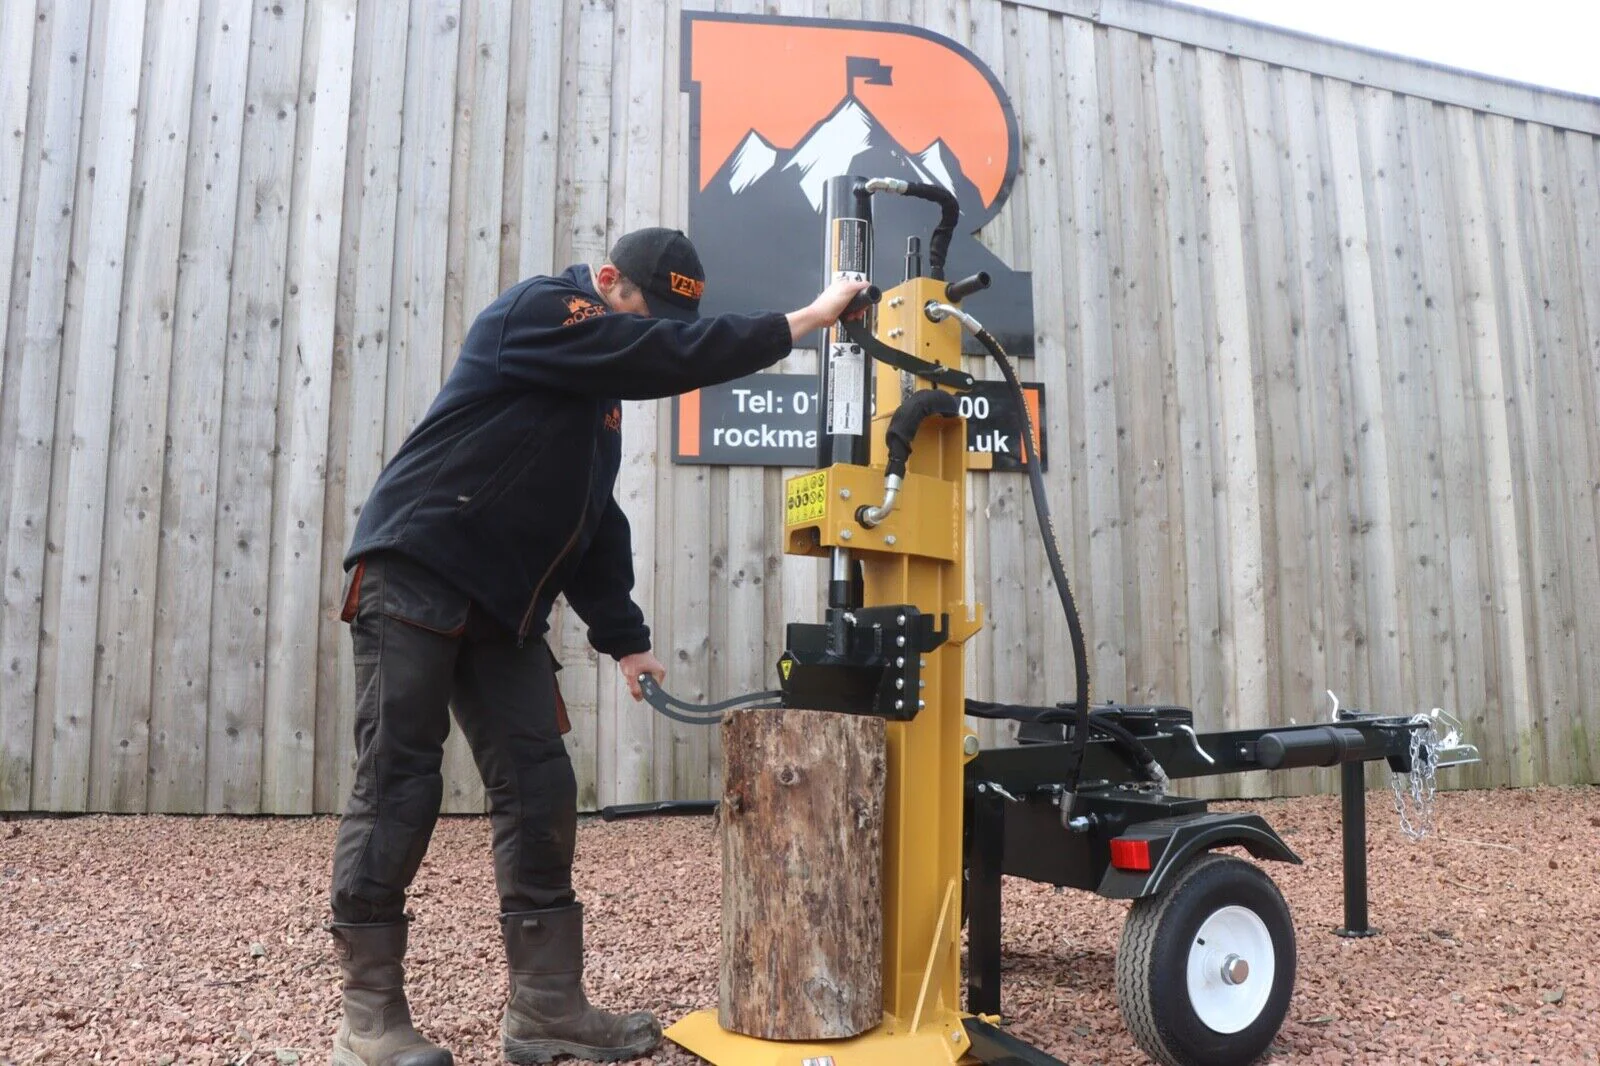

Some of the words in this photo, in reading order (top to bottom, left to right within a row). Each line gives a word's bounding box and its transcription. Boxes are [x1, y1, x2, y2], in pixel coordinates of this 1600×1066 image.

[731, 388, 783, 413] Tel:
[792, 391, 819, 415] 01
[958, 395, 990, 419] 00
[713, 423, 818, 449] rockma
[967, 429, 1010, 453] .uk
